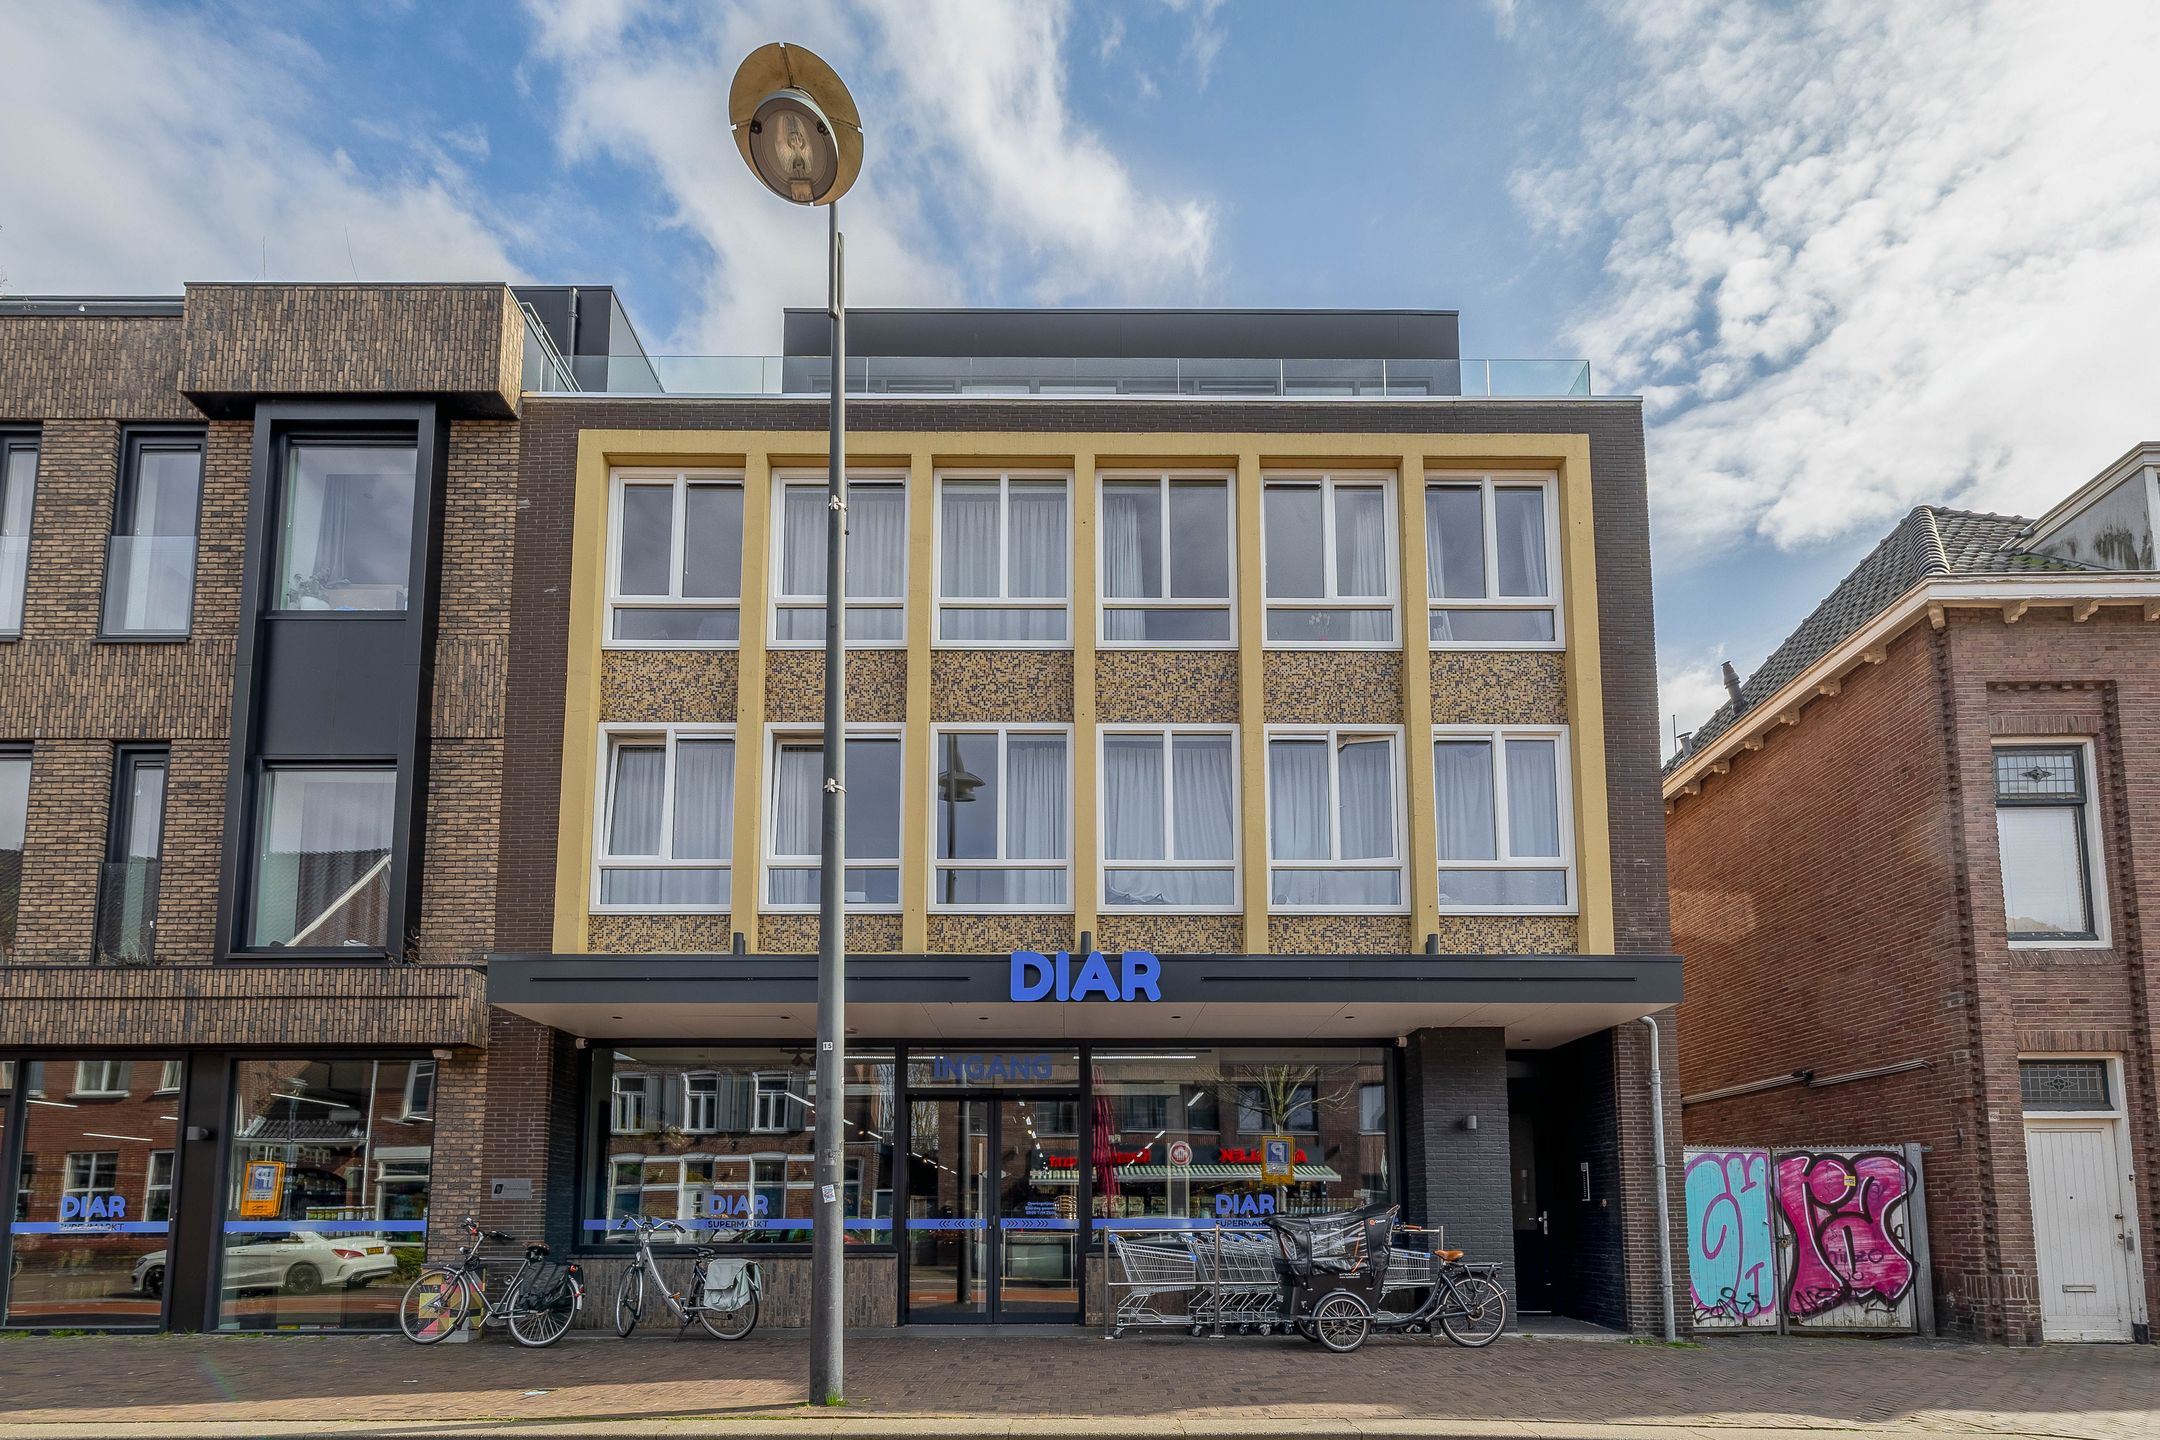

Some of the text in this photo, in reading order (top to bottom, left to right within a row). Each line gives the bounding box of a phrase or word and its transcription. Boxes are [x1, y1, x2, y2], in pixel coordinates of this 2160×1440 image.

[1010, 950, 1162, 1002] DIAR
[934, 1055, 1053, 1080] INGANG
[61, 1195, 126, 1218] DIAR
[709, 1194, 769, 1216] DIAR
[1215, 1194, 1275, 1214] DIAR
[708, 1220, 769, 1228] SUPERMARKT
